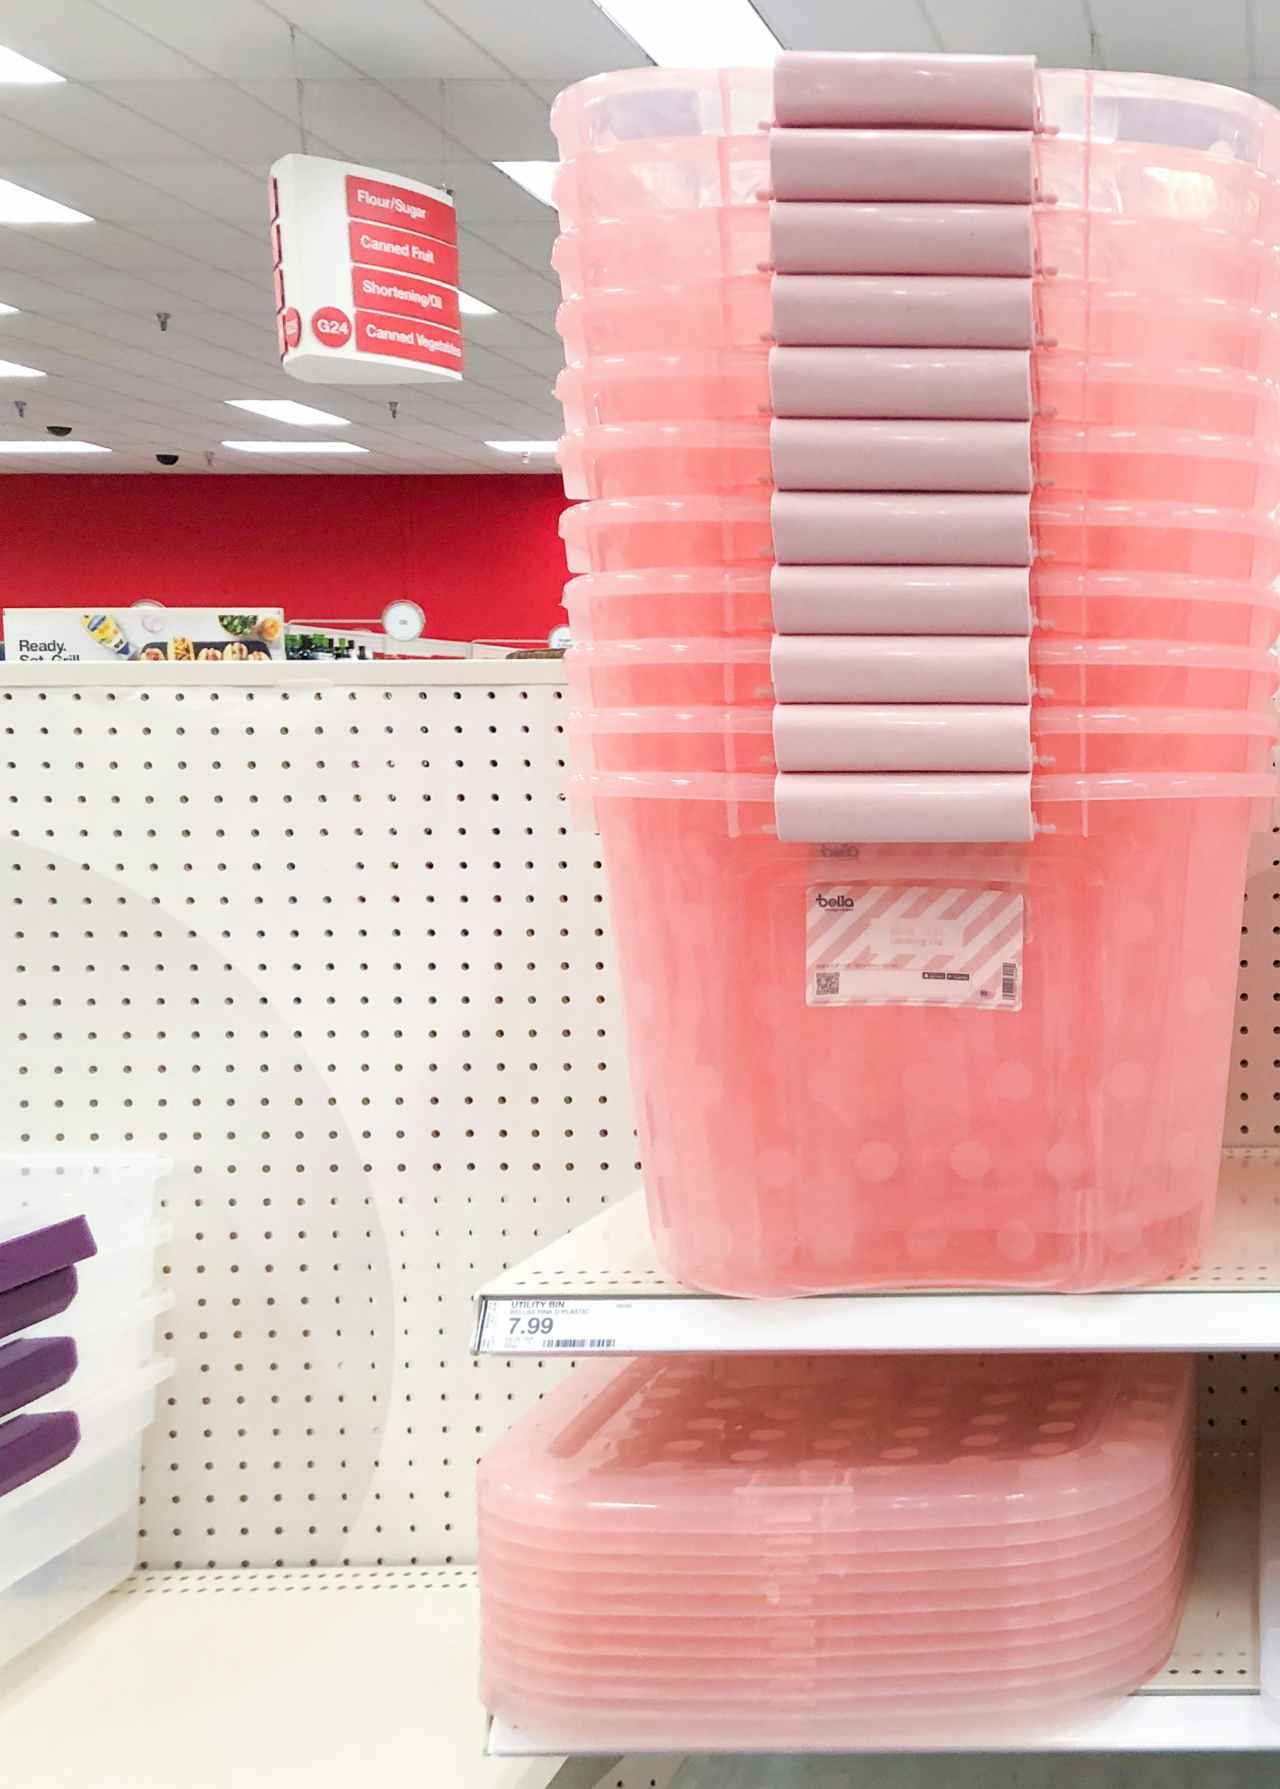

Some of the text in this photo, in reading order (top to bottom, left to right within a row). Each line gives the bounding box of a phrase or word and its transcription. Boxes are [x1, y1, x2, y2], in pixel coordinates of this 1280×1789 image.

[357, 189, 427, 219] Flour/Sugar
[360, 235, 435, 264] Canned Fruit
[363, 279, 443, 309] Shortening/Oil
[317, 318, 349, 335] G24
[366, 323, 415, 345] Canned
[19, 639, 67, 654] Ready.
[816, 893, 854, 908] bella
[511, 1301, 547, 1309] UTILITY
[509, 1317, 554, 1335] 7.99
